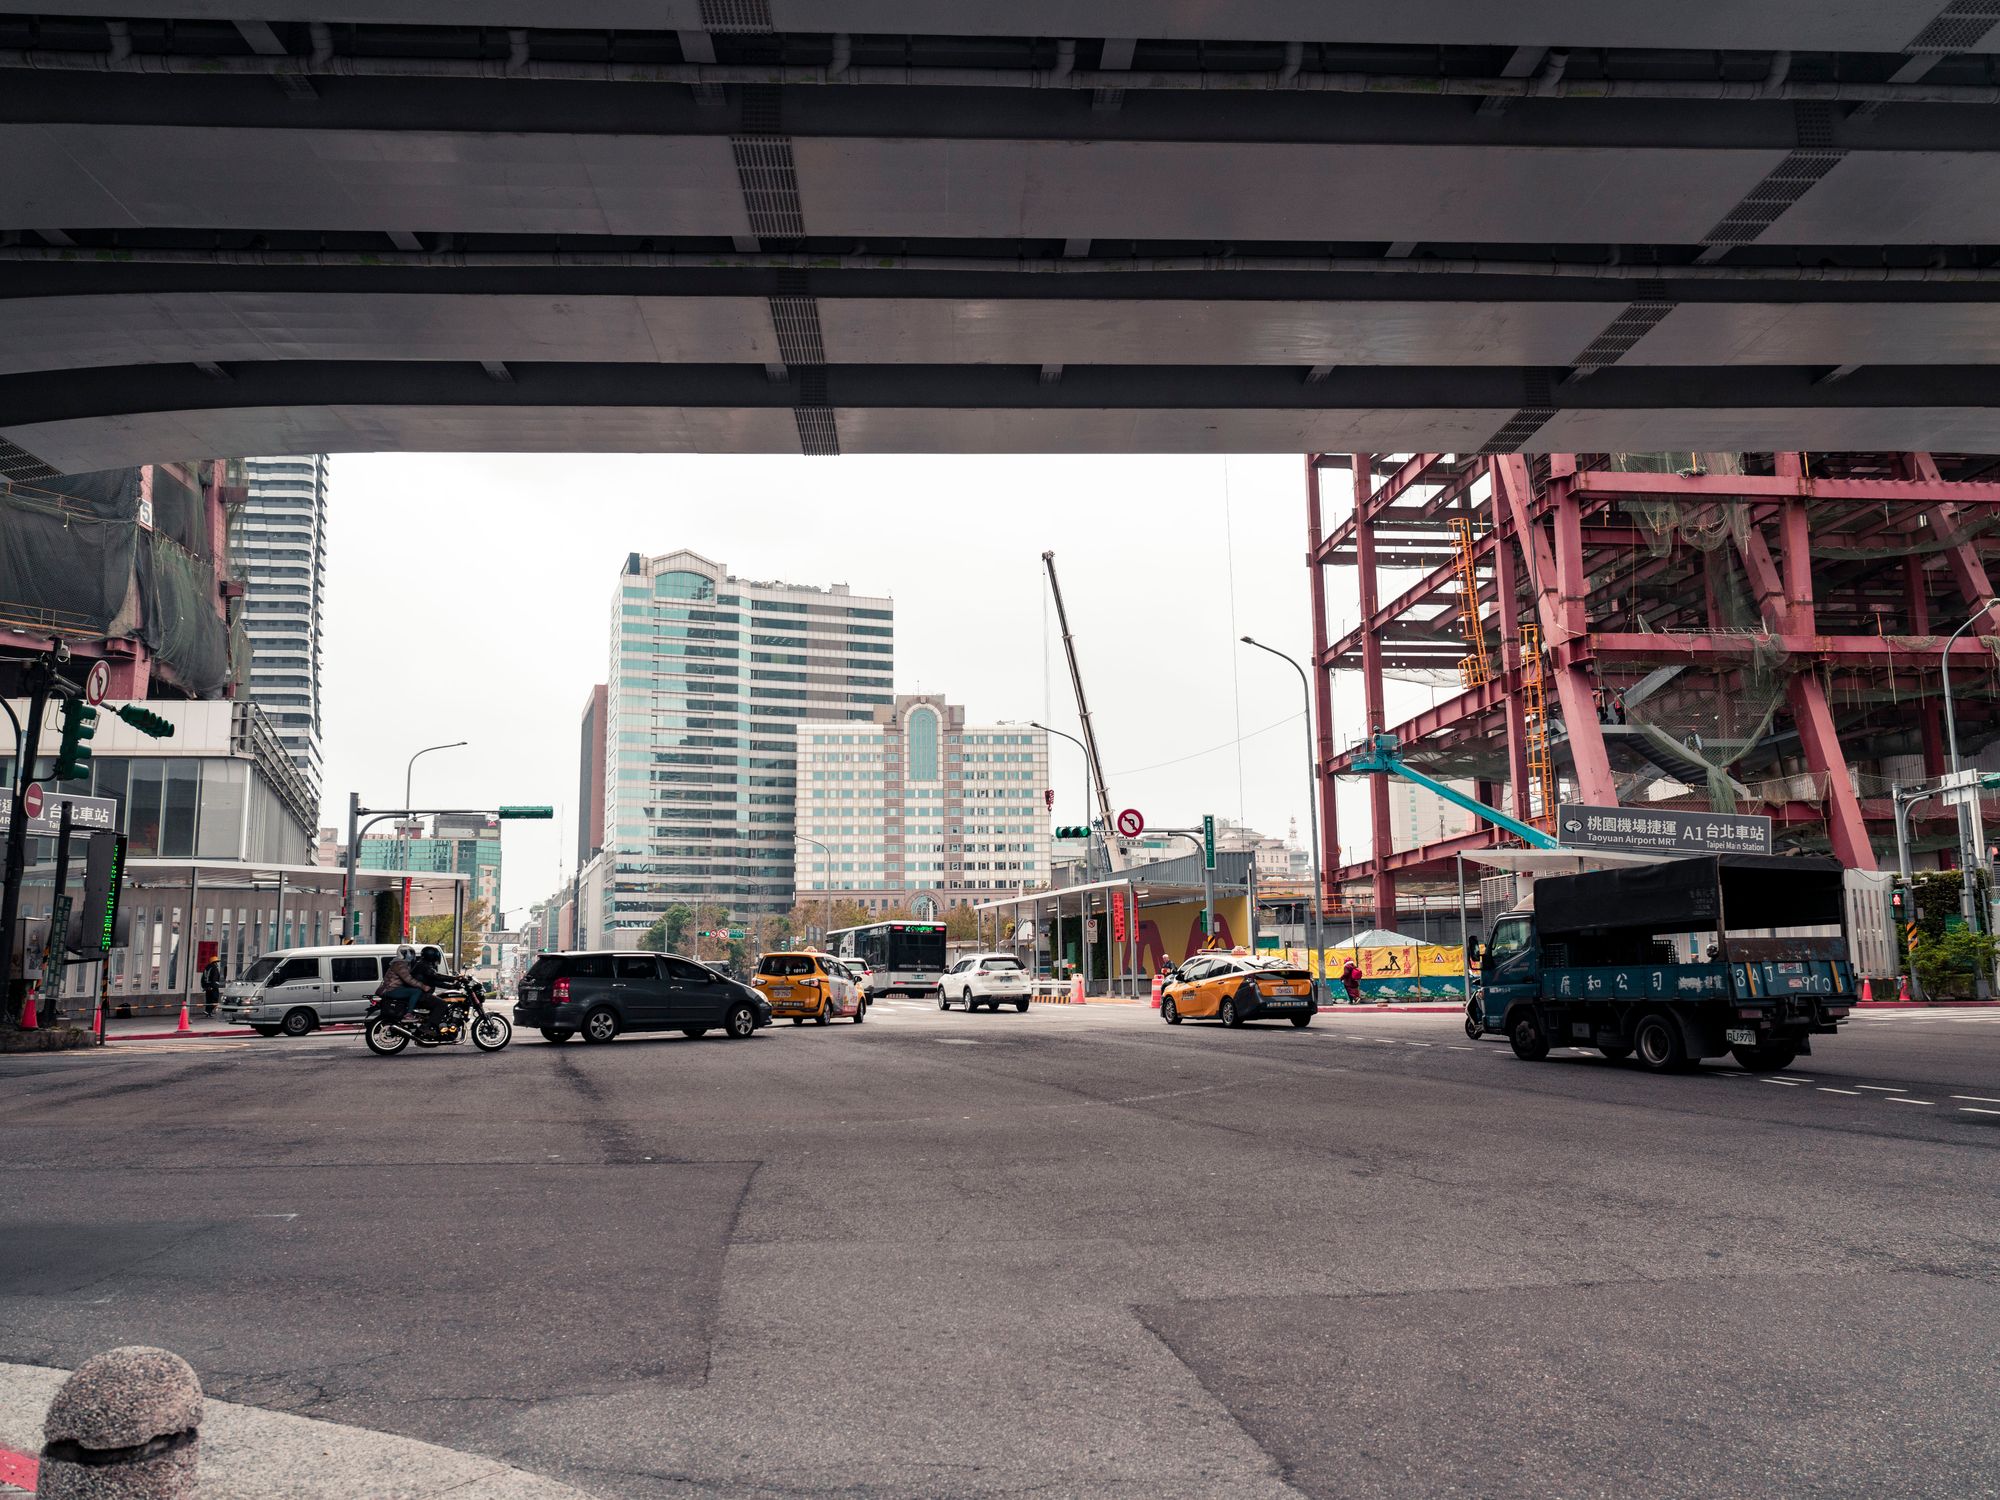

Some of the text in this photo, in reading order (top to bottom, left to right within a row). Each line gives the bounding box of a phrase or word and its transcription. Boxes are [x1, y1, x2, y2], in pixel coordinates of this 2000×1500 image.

[1587, 815, 1677, 836] 桃園機場捷運
[1683, 825, 1703, 841] A1
[1706, 823, 1765, 842] 台北車站
[1587, 833, 1676, 847] Taoyuan Airport MRT
[1706, 840, 1765, 852] Taipei Main Station
